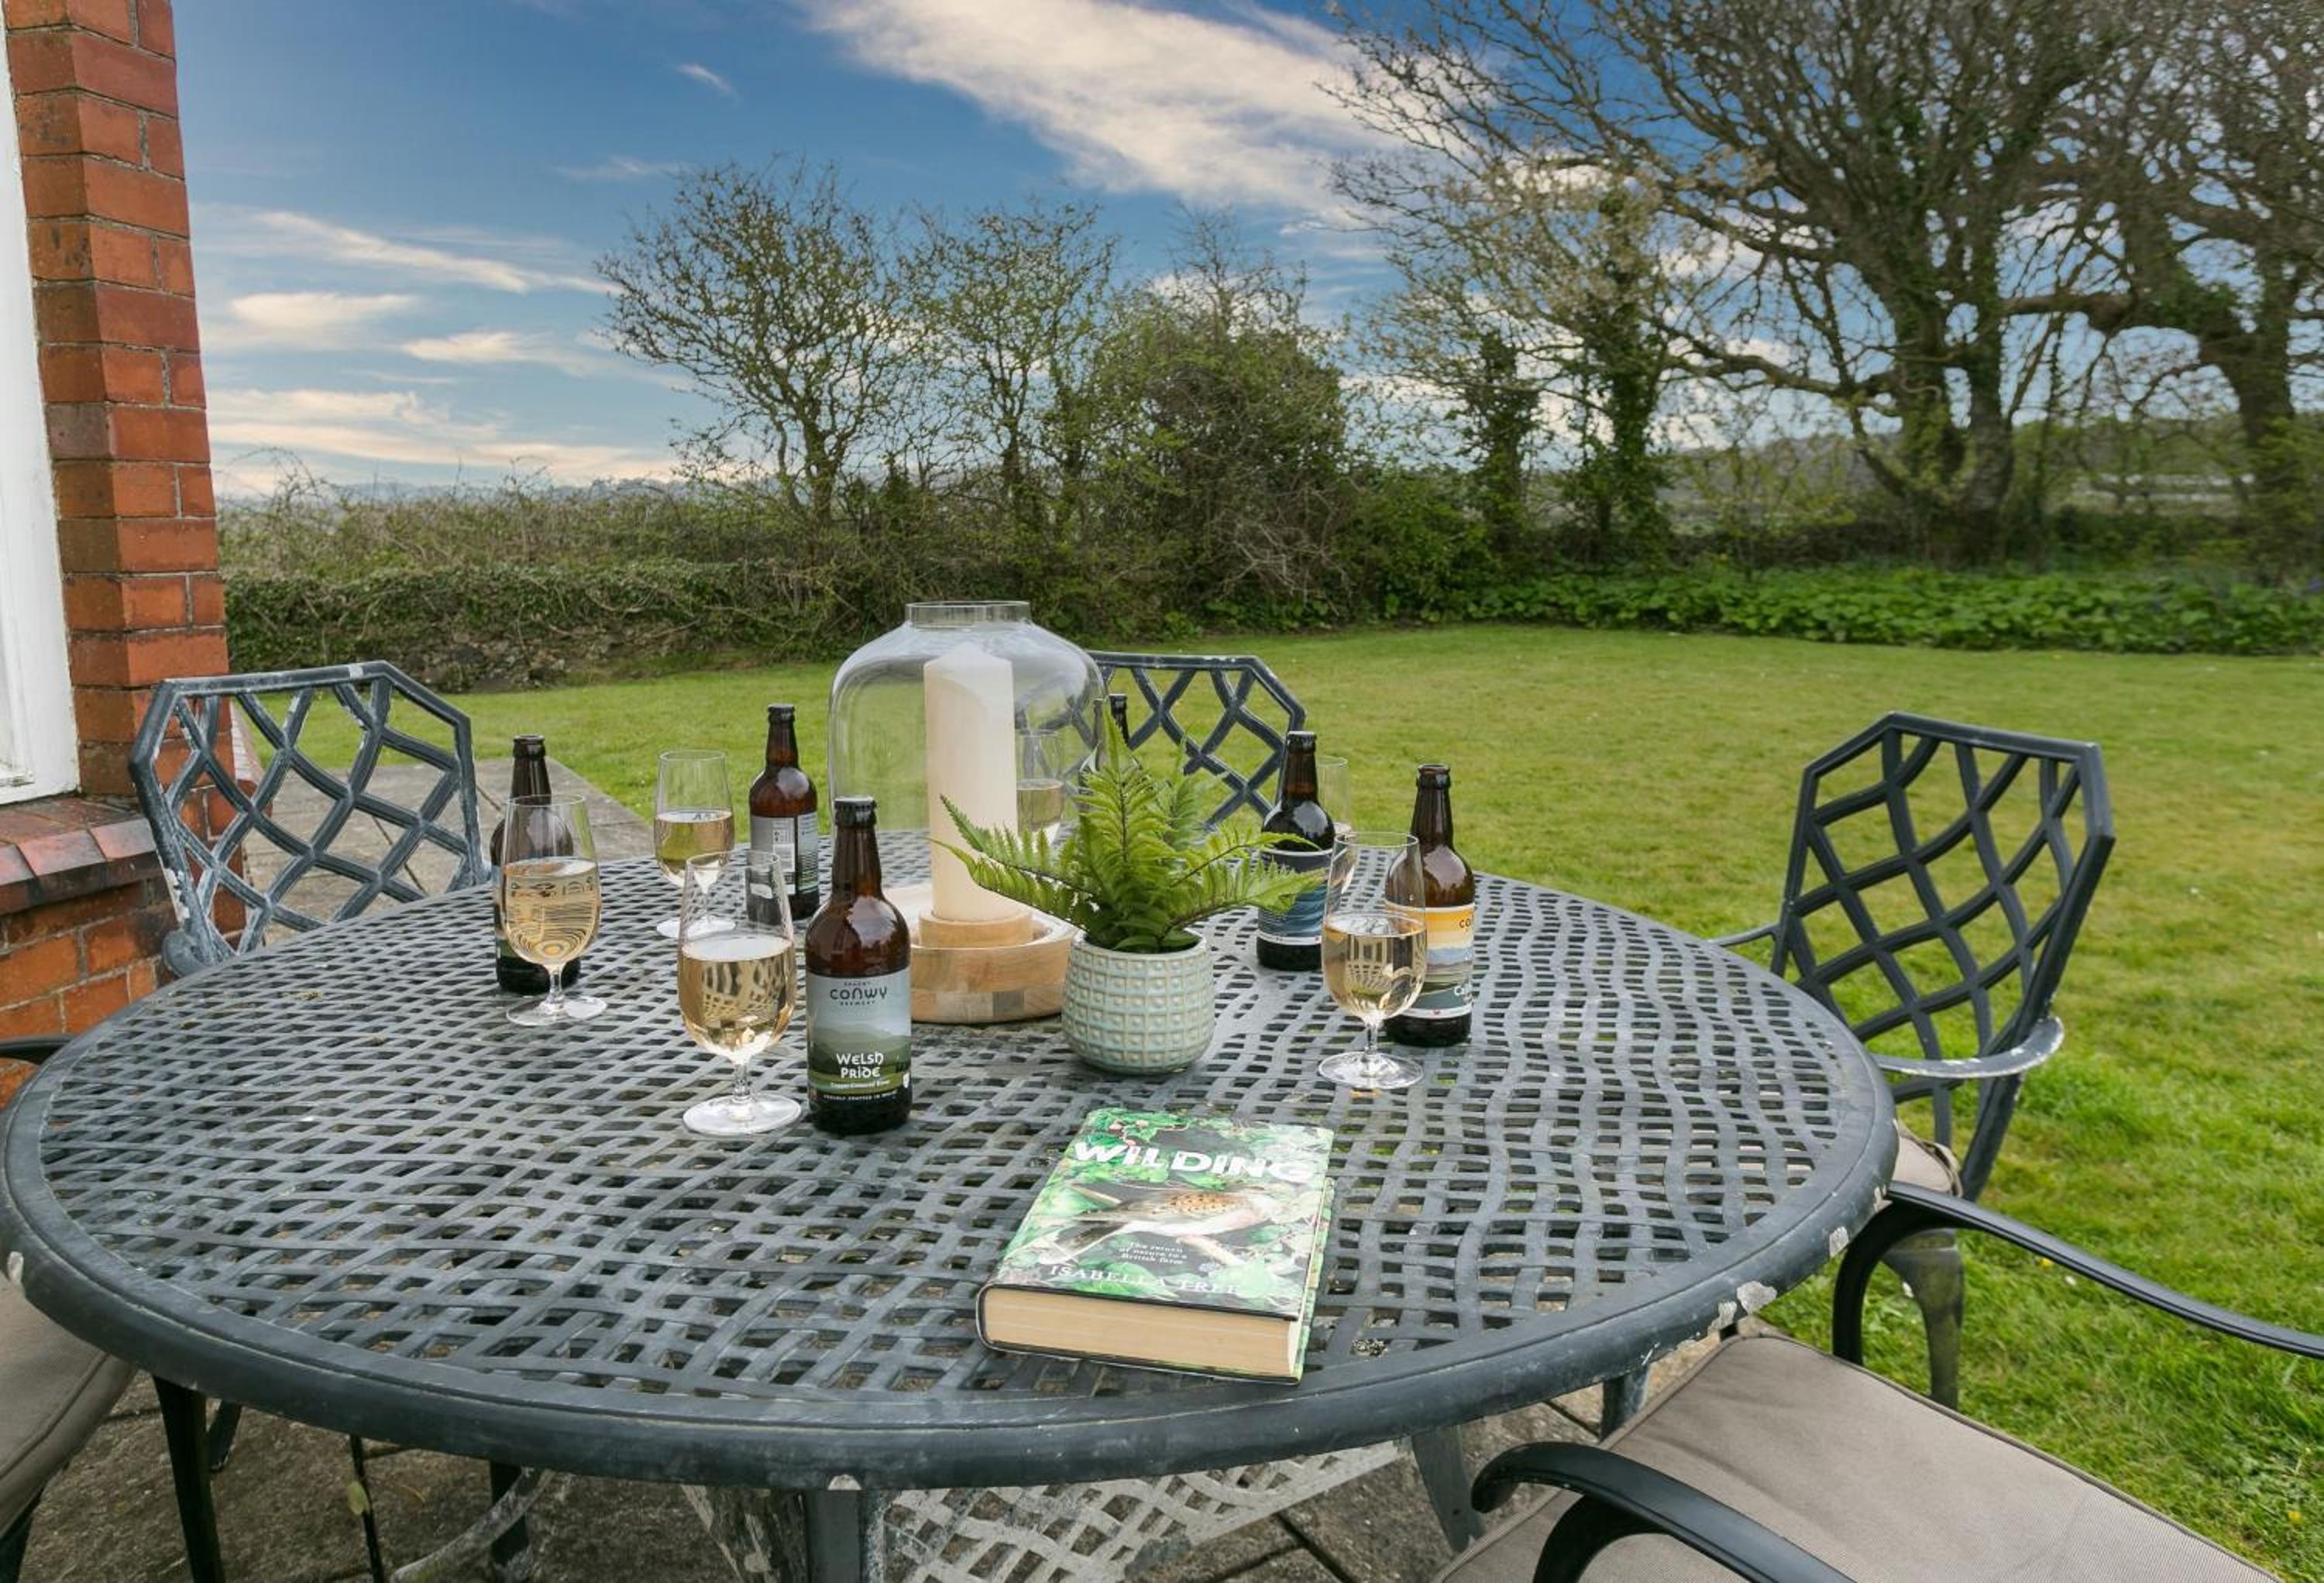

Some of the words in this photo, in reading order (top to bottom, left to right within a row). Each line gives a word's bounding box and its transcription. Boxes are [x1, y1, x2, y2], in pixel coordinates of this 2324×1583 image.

[830, 986, 887, 1000] CONWY
[836, 1051, 884, 1065] WELSH
[841, 1066, 881, 1079] PRIDE
[1074, 1142, 1315, 1184] WILDING
